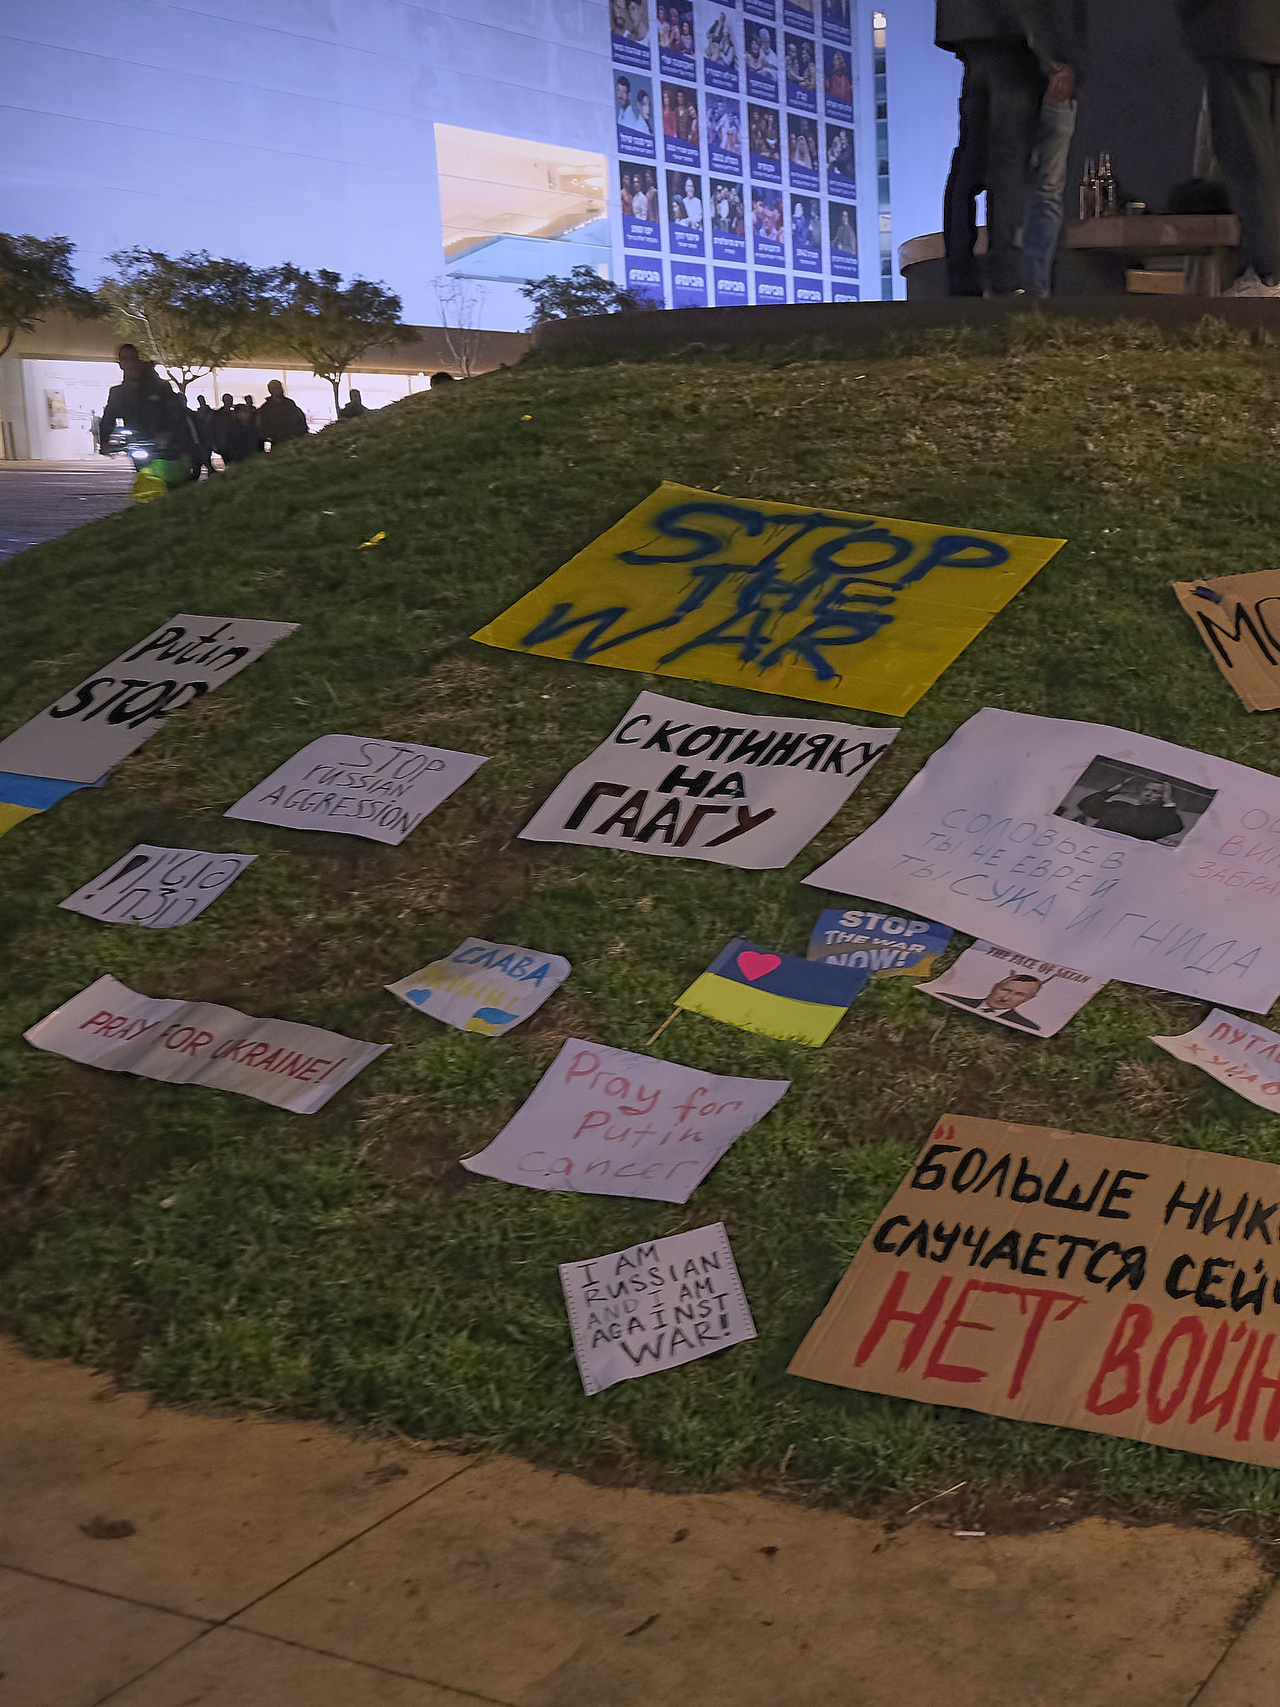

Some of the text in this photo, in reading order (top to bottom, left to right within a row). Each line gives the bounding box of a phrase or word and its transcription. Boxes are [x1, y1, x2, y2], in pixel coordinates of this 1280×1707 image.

[617, 502, 1010, 589] STOP
[681, 563, 904, 617] THE
[519, 602, 896, 684] WAR
[50, 676, 214, 730] STOP
[339, 741, 446, 782] STOP
[614, 713, 888, 778] СКОТИНЯКУ
[660, 764, 746, 799] НА
[259, 784, 426, 834] AGGRESSION
[562, 781, 777, 848] ГААГУ
[923, 831, 1121, 896] ТЫ НЕ ЕВРЕЙ
[941, 807, 1126, 870] СОЛОВЬЕВ
[824, 930, 927, 954] THE WAR
[838, 910, 930, 938] STOP
[948, 872, 1056, 922] СУКА
[1104, 911, 1263, 979] ГНИДА
[452, 946, 551, 987] СЛАВА
[986, 946, 1093, 984] THE FACE OF SATAN
[79, 1010, 348, 1084] PRAY FOR UKRAINE!
[564, 1050, 744, 1124] Pray for
[572, 1109, 704, 1147] Putin
[516, 1150, 699, 1180] cancer
[576, 1244, 660, 1289] I AM
[584, 1251, 722, 1308] RUSSIAN
[872, 1214, 1146, 1293] СЛУЧАЕТСЯ
[587, 1277, 716, 1330] AND I AM
[592, 1292, 730, 1348] AGAINST
[619, 1314, 732, 1367] WAR!
[853, 1270, 1089, 1400] НЕТ
